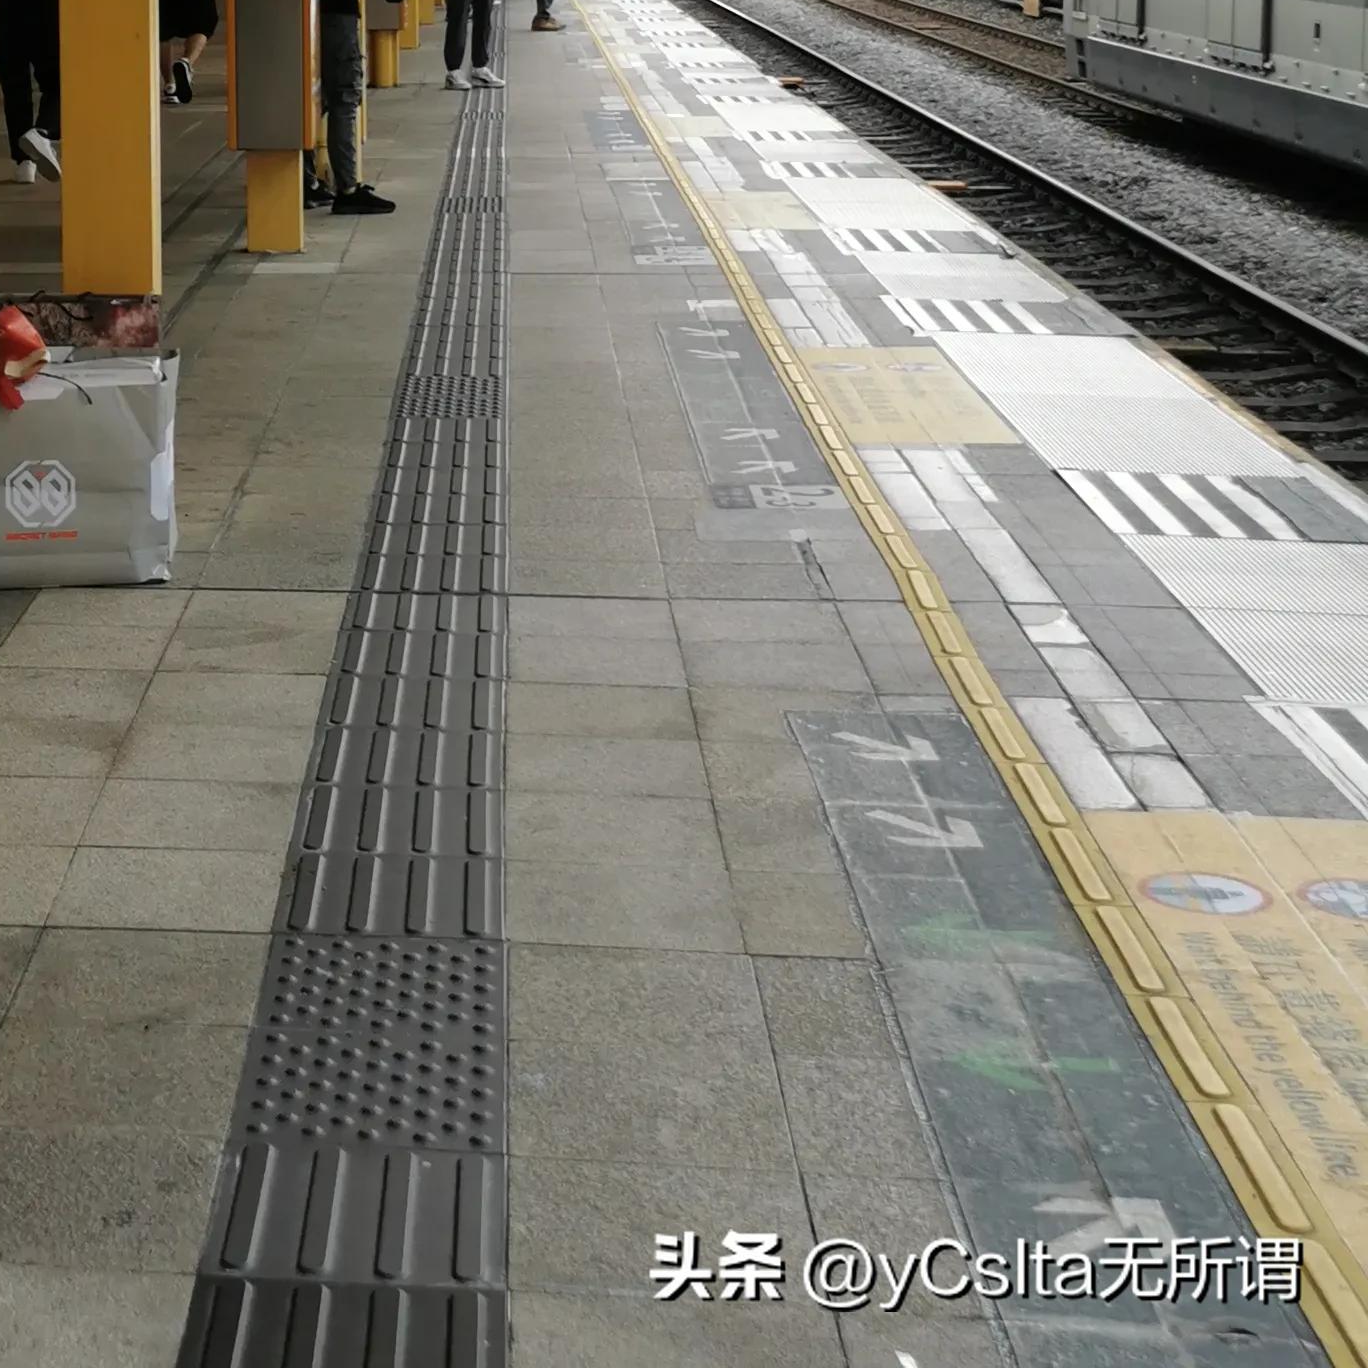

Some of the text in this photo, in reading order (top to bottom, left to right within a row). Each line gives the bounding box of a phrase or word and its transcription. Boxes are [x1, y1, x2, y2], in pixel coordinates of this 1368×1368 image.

[1198, 967, 1279, 1031] behind
[1244, 1034, 1288, 1064] the
[1253, 1066, 1333, 1132] yellow
